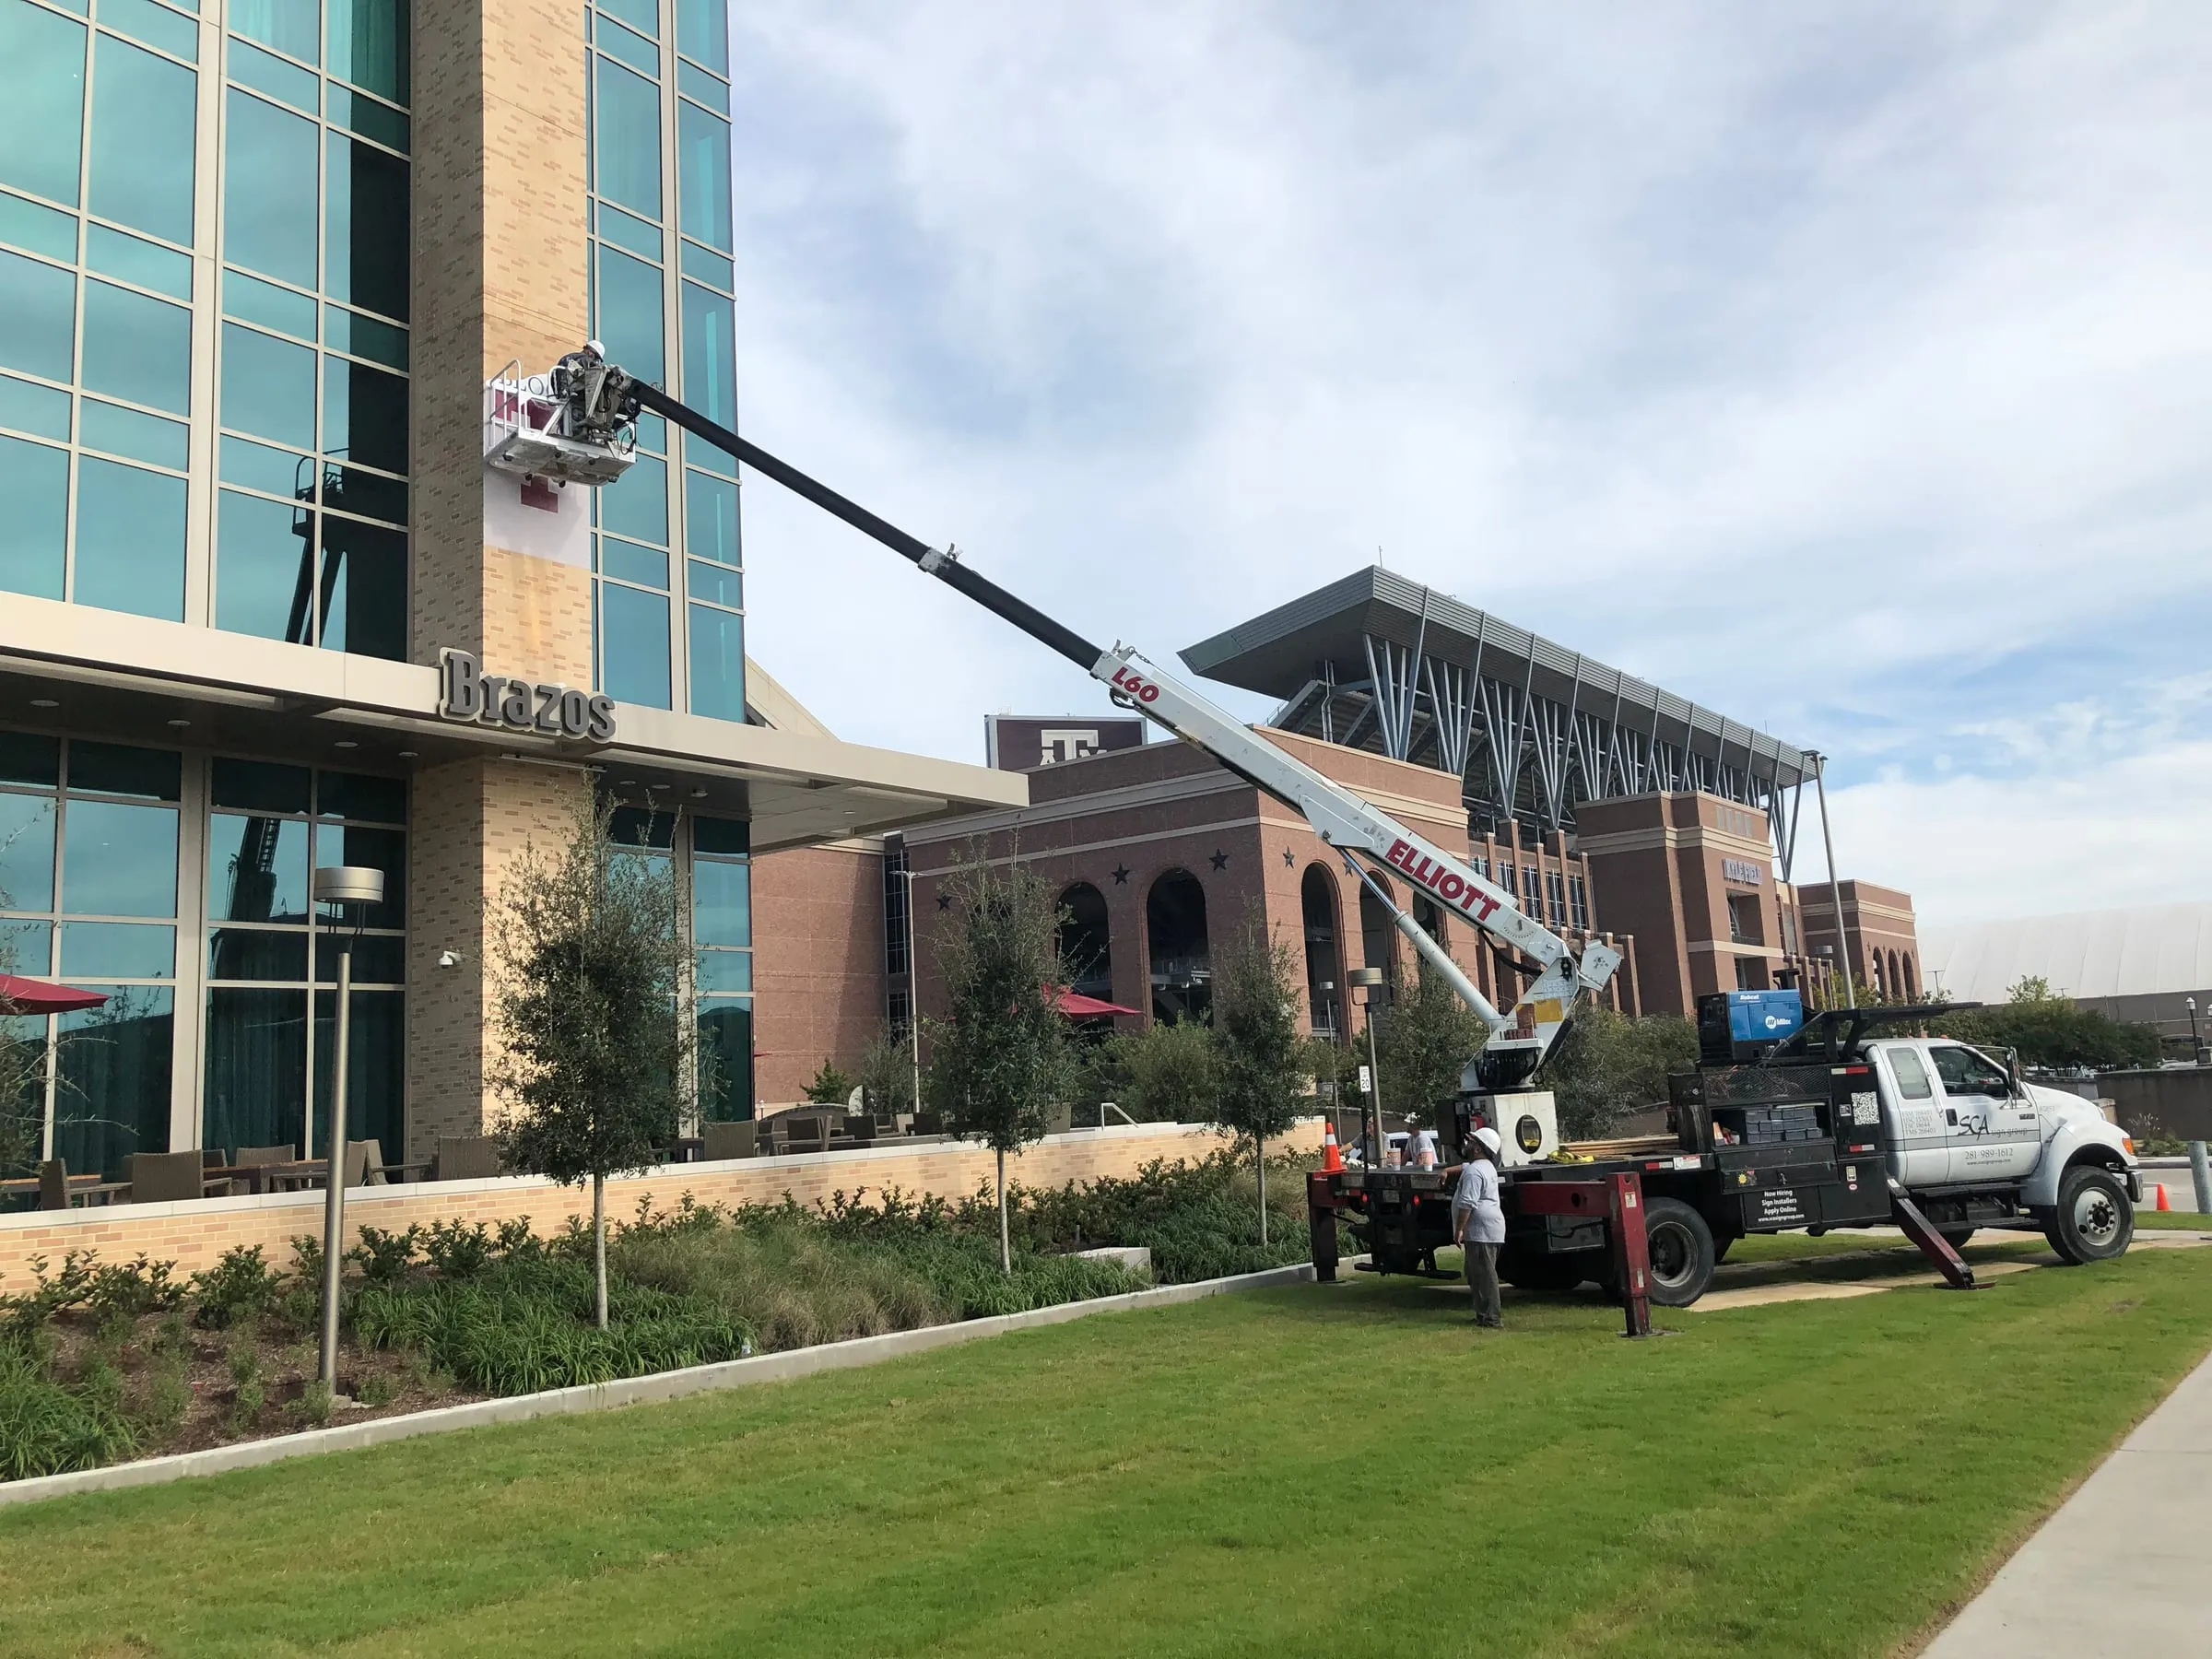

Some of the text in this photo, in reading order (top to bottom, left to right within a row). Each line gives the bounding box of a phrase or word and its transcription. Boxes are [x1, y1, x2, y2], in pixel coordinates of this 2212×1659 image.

[443, 649, 617, 740] Brazos
[1112, 666, 1159, 702] L60
[1385, 838, 1501, 922] ELLIOTT
[1361, 1078, 1369, 1088] 20
[1958, 1114, 1990, 1140] SCA
[1965, 1147, 2014, 1159] 281-989-1612
[1764, 1207, 1779, 1216] Apply
